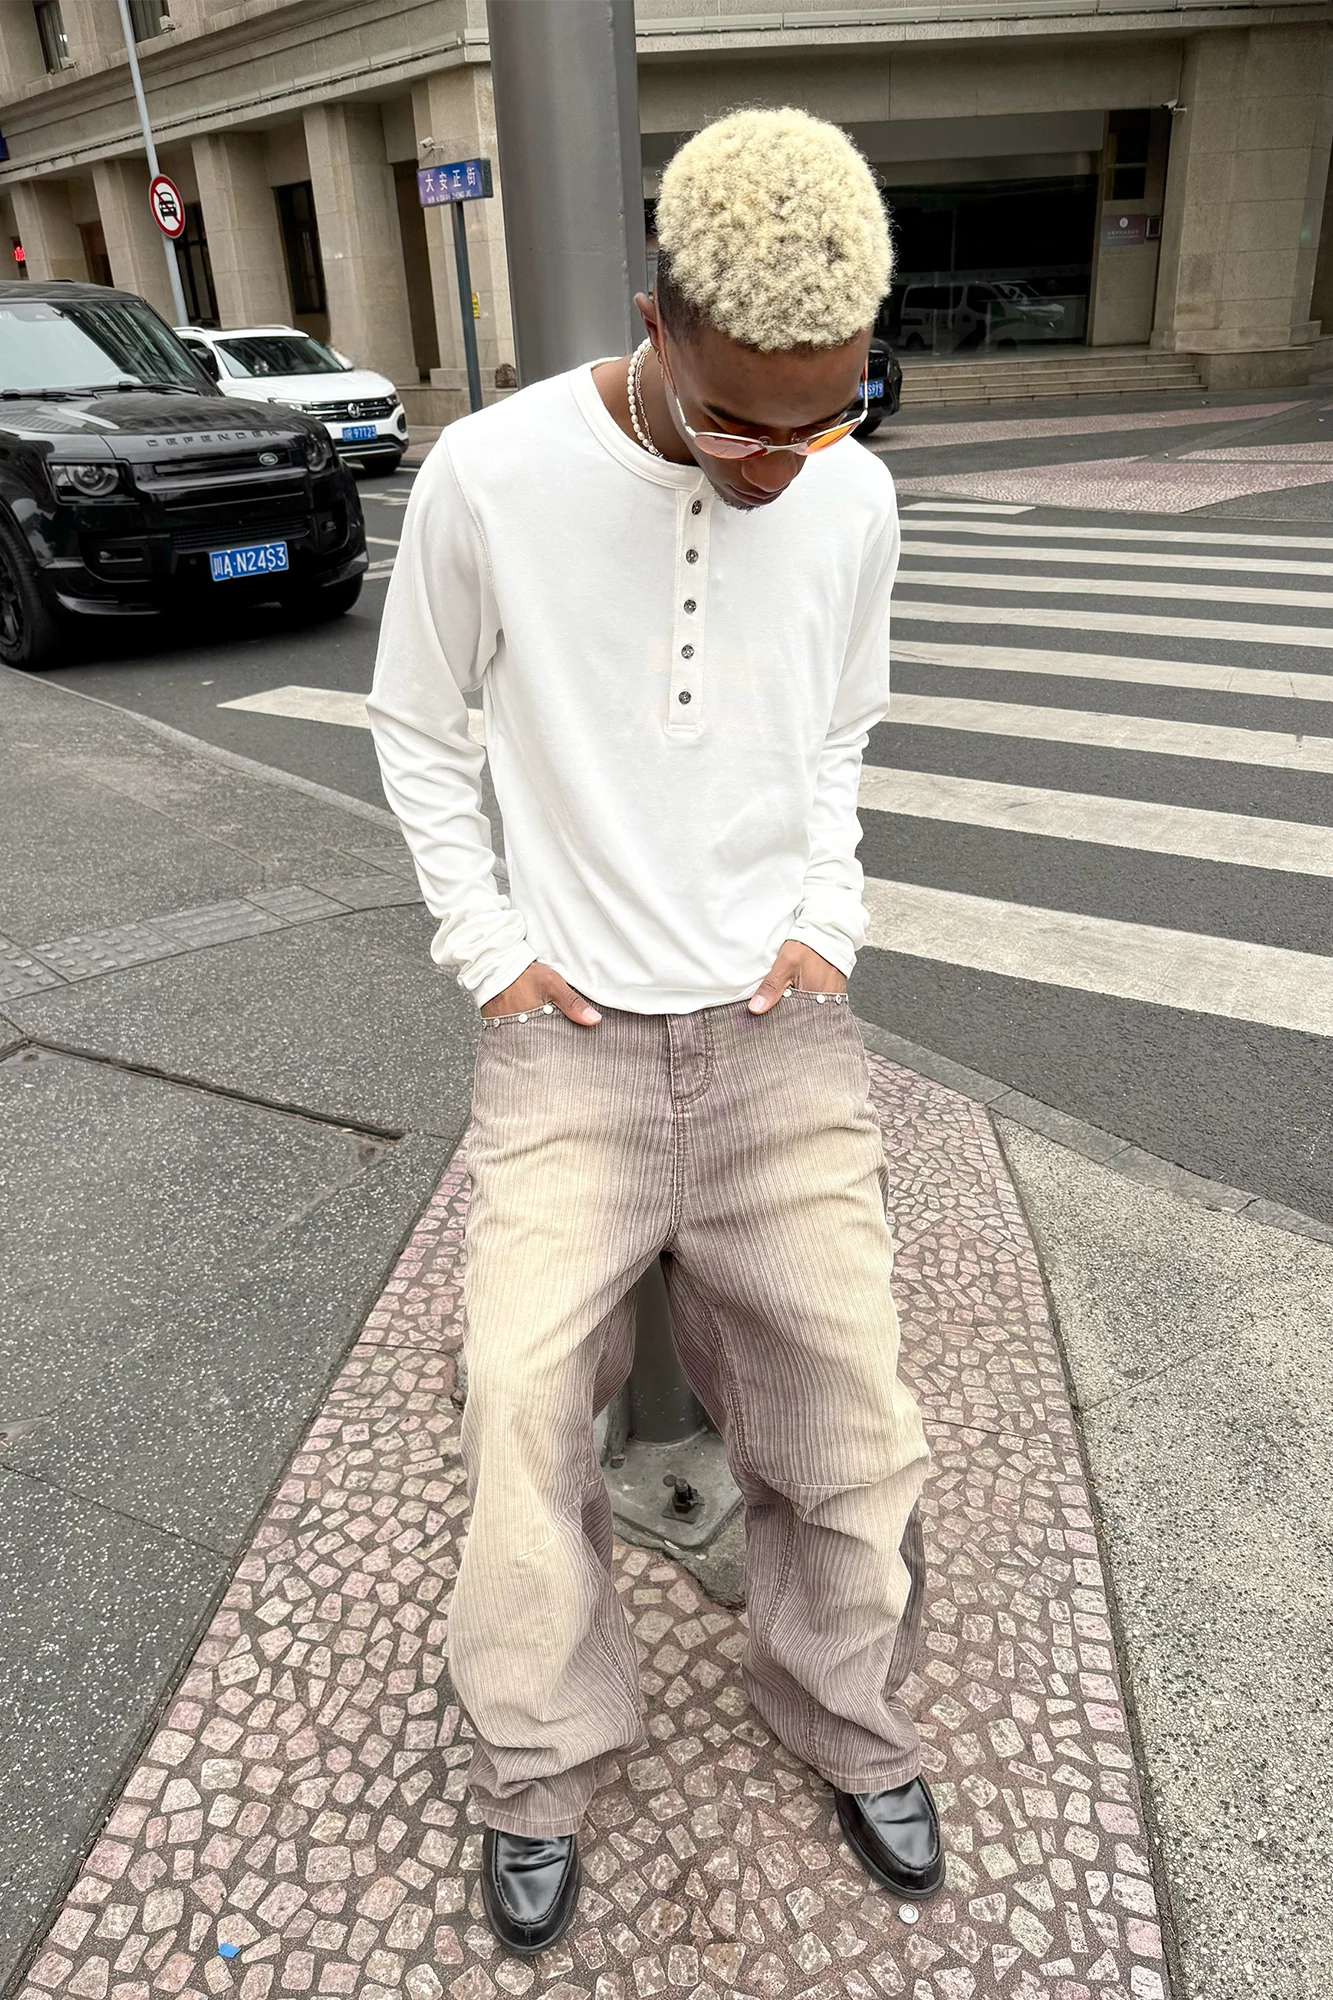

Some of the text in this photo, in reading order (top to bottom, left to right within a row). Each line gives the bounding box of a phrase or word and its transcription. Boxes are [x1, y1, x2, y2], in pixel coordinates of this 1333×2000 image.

[425, 167, 476, 193] 大安正街
[146, 430, 280, 447] DEFENDER
